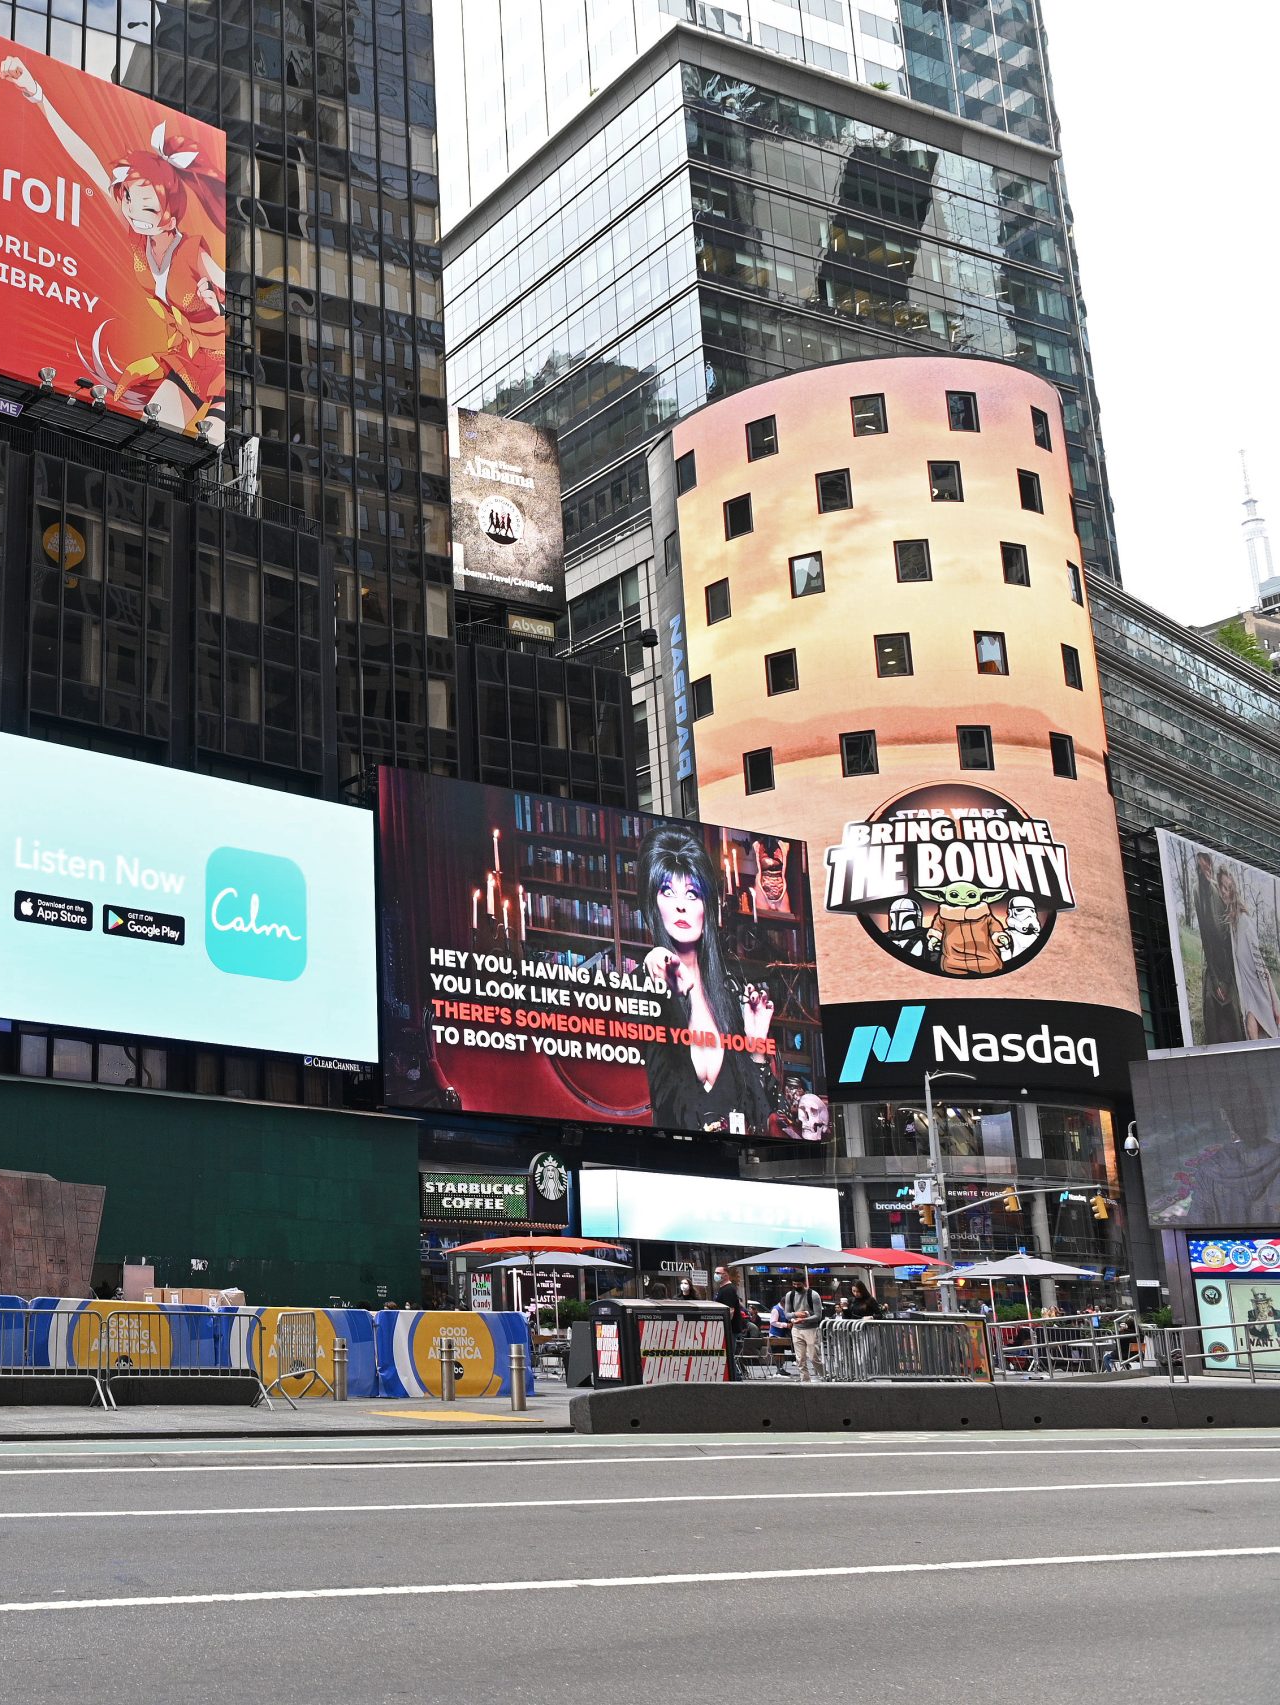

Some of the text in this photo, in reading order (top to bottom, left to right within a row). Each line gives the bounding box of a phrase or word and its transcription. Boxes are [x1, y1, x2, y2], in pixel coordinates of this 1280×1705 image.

[463, 459, 535, 490] Alabama
[670, 613, 691, 781] NASDAQ
[889, 808, 1008, 820] STAR WARS
[850, 819, 1051, 845] BRING HOME
[15, 836, 186, 894] Listen Now
[830, 842, 1072, 907] THE BOUNTY
[37, 898, 66, 909] Download
[75, 905, 85, 913] the
[37, 907, 87, 925] App Store
[127, 912, 139, 920] GET
[211, 887, 302, 942] Calm
[127, 920, 180, 941] Google Play
[430, 948, 672, 999] HEY YOU, HAVING A SALAD,
[431, 973, 662, 1017] YOU LOOK LIKE YOU NEED
[516, 1010, 603, 1037] SOMEONE
[609, 1021, 666, 1044] INSIDE
[670, 1028, 718, 1050] YOUR
[719, 1033, 776, 1055] HOUSE
[433, 1024, 646, 1065] TO BOOST YOUR MOOD.
[932, 1024, 1100, 1077] Nasdaq
[425, 1181, 525, 1196] STARBUCKS
[442, 1197, 504, 1210] COFFEE
[876, 1202, 912, 1210] branded
[660, 1260, 695, 1272] CITIZEN
[472, 1273, 491, 1283] ATM
[472, 1287, 491, 1296] Drink
[472, 1299, 491, 1310] Candy
[108, 1317, 142, 1329] GOOD
[440, 1327, 467, 1336] GOOD
[433, 1337, 475, 1346] MNING
[640, 1321, 724, 1349] HATE HAS NO
[91, 1338, 157, 1354] AMERICA
[428, 1347, 482, 1360] AMRICA
[687, 1356, 726, 1382] HERE
